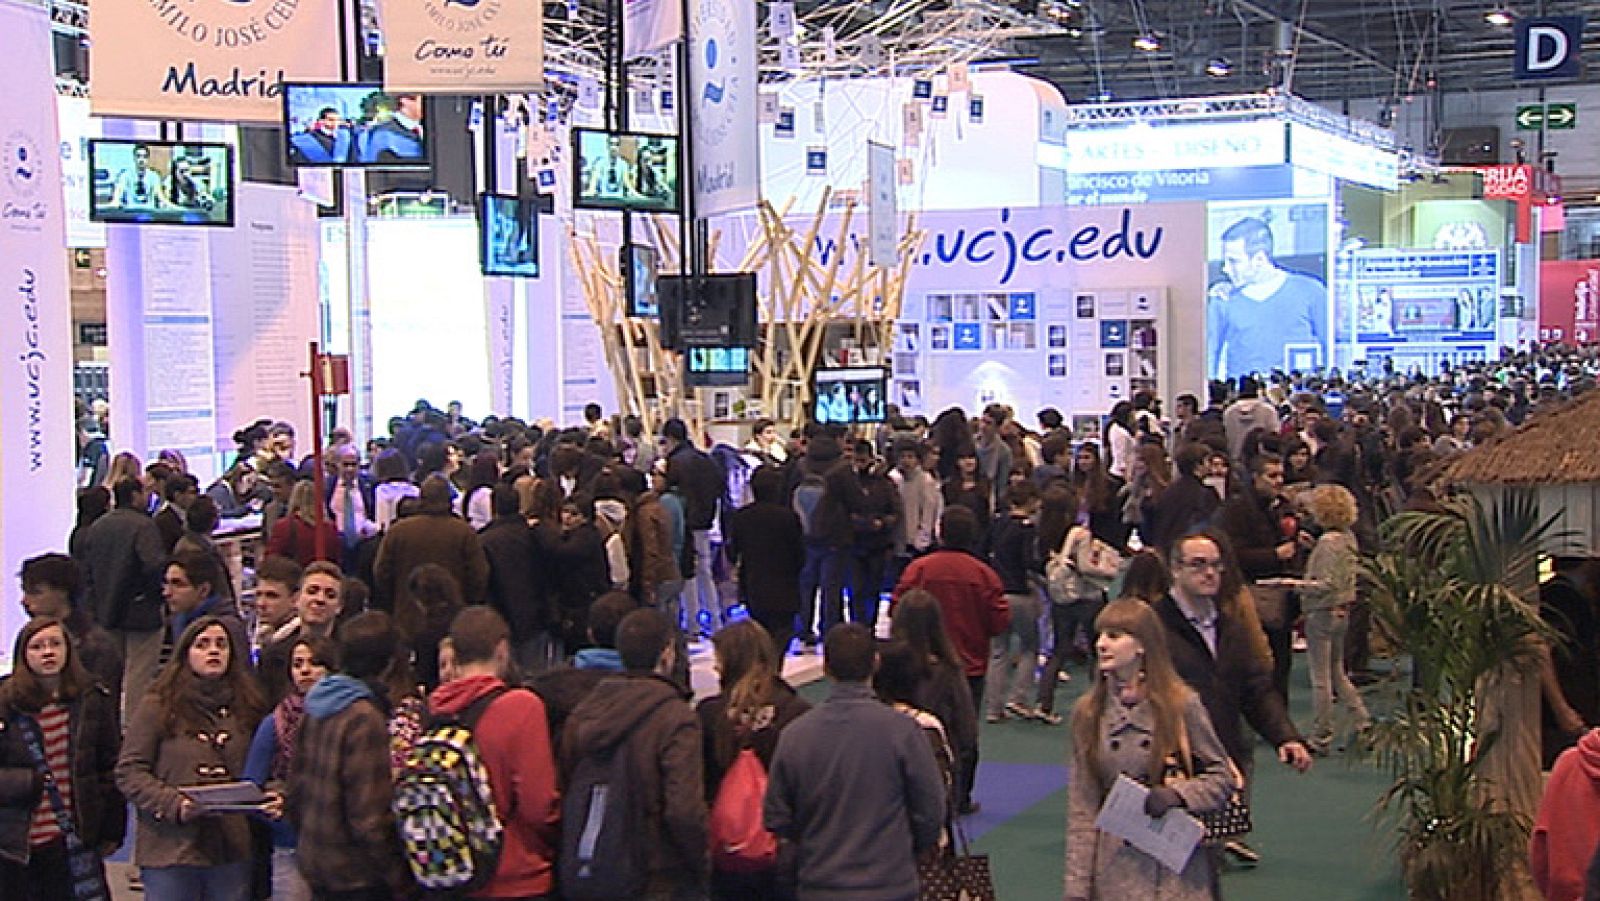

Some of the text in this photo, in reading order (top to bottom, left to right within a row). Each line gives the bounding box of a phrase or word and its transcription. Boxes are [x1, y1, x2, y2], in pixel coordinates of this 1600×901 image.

[214, 17, 267, 47] JOSÉ
[1527, 26, 1568, 70] D
[414, 39, 474, 61] Como
[161, 62, 284, 98] Madrid
[1155, 171, 1209, 186] Vitoria
[17, 268, 46, 472] www.ucjc.edu
